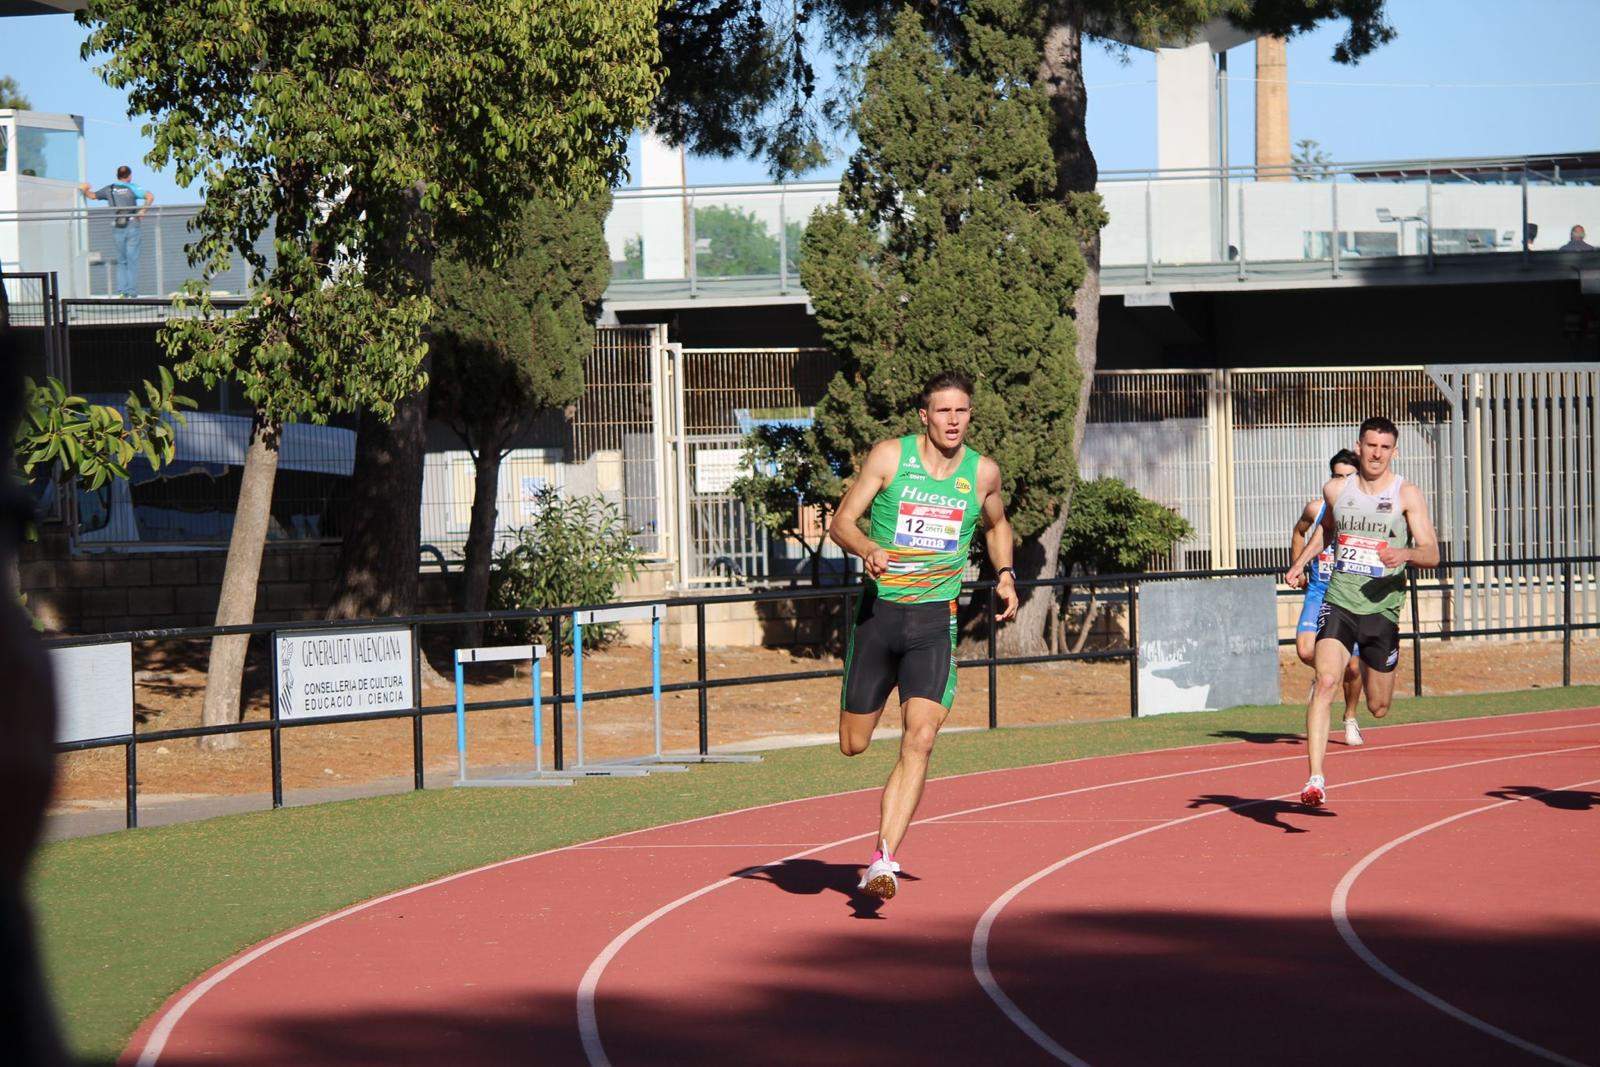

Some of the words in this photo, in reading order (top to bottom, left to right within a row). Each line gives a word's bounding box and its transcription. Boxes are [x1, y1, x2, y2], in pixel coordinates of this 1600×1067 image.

[900, 485, 968, 510] Huesca
[905, 518, 925, 534] 12
[1340, 547, 1357, 561] 22
[302, 638, 351, 667] GENERALITAT
[353, 635, 402, 664] VALENCIANA
[304, 680, 357, 696] CONSELLERIA
[358, 678, 368, 691] DE
[370, 675, 404, 690] CULTURA
[304, 695, 353, 711] EDUCACIO
[358, 694, 362, 706] I
[368, 690, 404, 705] CIENCIA
